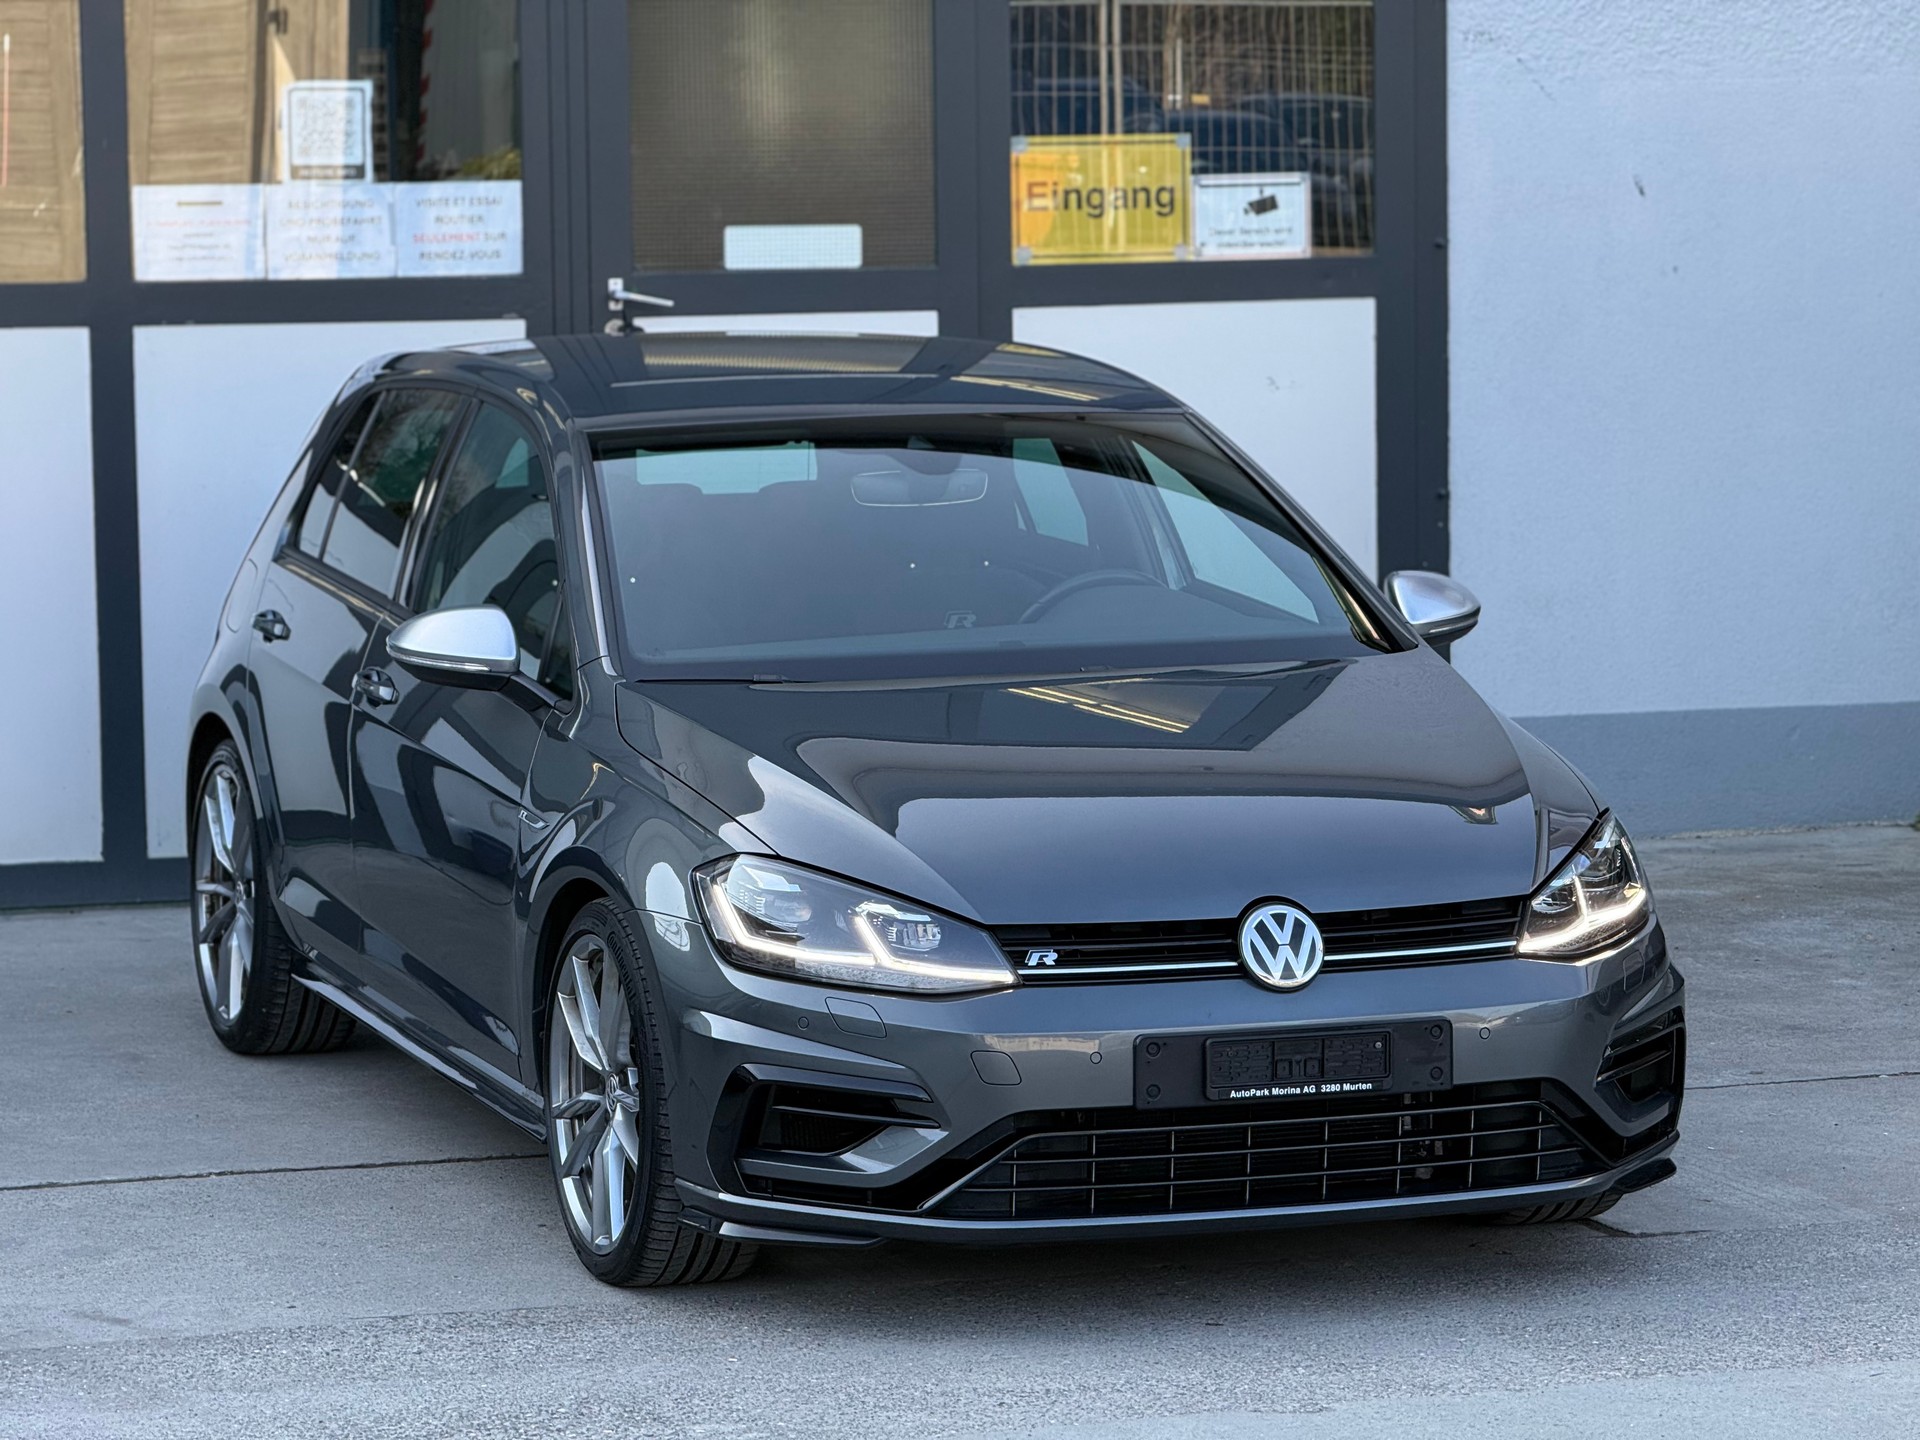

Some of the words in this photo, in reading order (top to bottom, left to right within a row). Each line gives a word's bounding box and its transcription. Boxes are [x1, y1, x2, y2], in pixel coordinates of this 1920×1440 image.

[1026, 181, 1176, 219] Eingang
[1230, 1088, 1269, 1098] AutoPark
[1271, 1086, 1301, 1096] Morina
[1303, 1084, 1316, 1094] AG
[1320, 1083, 1341, 1093] 3280
[1342, 1082, 1373, 1092] Murten
